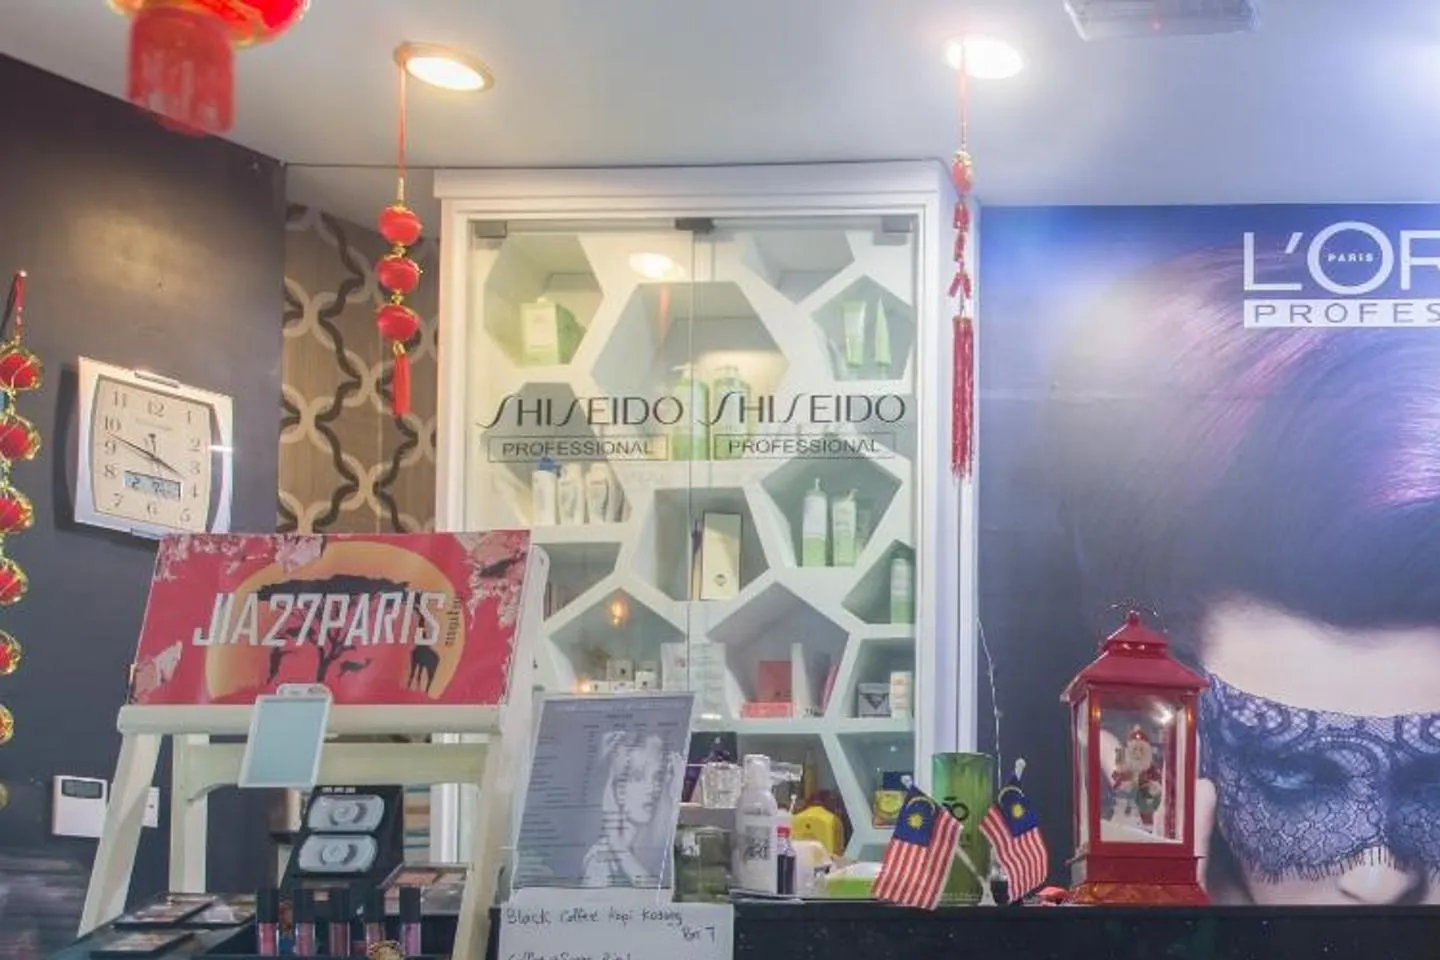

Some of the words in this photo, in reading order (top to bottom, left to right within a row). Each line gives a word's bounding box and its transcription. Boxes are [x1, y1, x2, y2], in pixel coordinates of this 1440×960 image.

[1327, 253, 1375, 263] PARIS
[475, 395, 685, 427] SHISEIDO
[696, 393, 906, 425] SHISEIDO
[501, 440, 655, 457] PROFESSIONAL
[727, 438, 883, 456] PROFESSIONAL
[191, 590, 447, 647] JIA27PARIS
